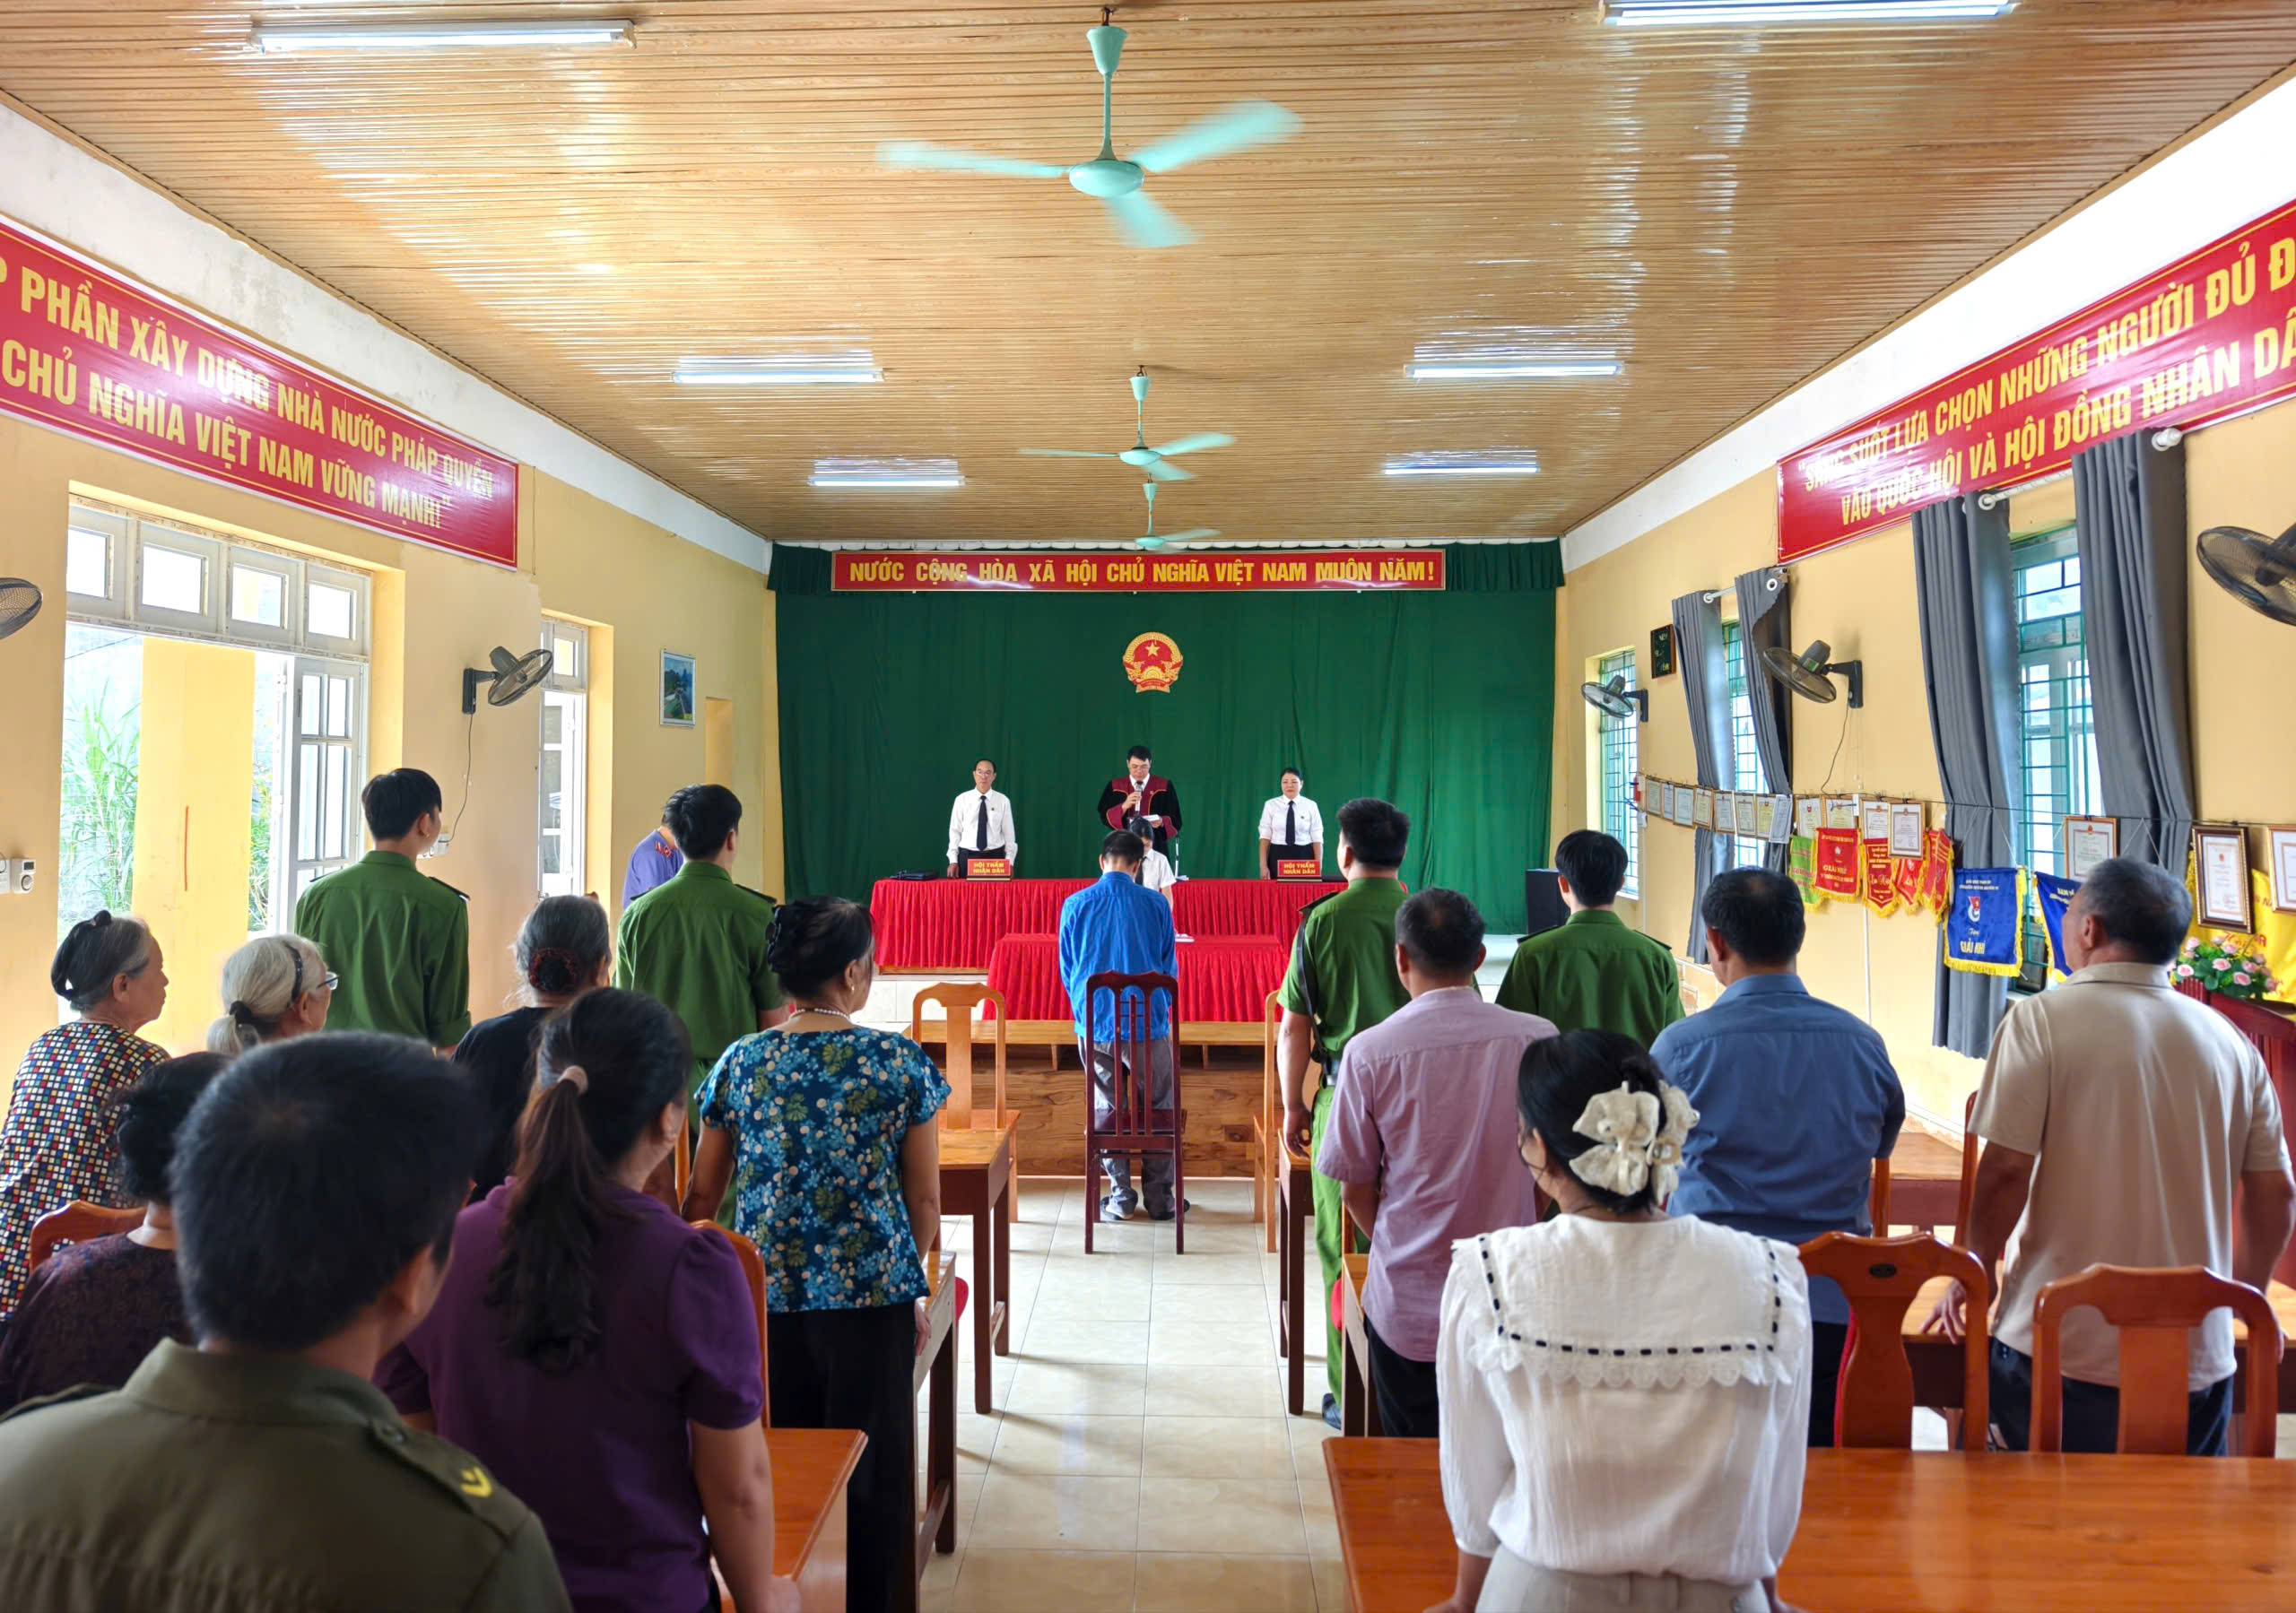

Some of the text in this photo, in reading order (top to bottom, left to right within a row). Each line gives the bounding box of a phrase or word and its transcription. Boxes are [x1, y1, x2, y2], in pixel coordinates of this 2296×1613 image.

[2, 339, 77, 405] CHỦ
[89, 371, 187, 446] NGHĨA
[196, 412, 251, 470] VIỆT
[259, 436, 313, 489] NAM
[321, 458, 376, 508] VỮNG
[22, 265, 119, 351] PHẦN
[129, 316, 189, 377] XÂY
[197, 347, 269, 412] DỰNG
[278, 382, 325, 435] NHÀ
[332, 406, 387, 457] NƯỚC
[392, 430, 439, 474] PHÁP
[443, 455, 492, 499] QUYỀN
[1894, 410, 1928, 455] LỰA
[1935, 378, 1993, 436] CHỌN
[2000, 335, 2088, 409] NHỮNG
[2097, 282, 2194, 366] NGƯỜI
[2205, 240, 2256, 319] ĐỦ
[1929, 447, 1963, 495] HỘI
[1969, 432, 1997, 481] VÀ
[2005, 415, 2046, 470] HỘI
[2053, 384, 2131, 451] ĐỒNG
[2141, 340, 2239, 420] NHÂN
[849, 557, 905, 582] NƯỚC
[916, 558, 968, 585] CỘNG
[978, 558, 1018, 582] HÒA
[1029, 559, 1056, 583] XÃ
[1065, 559, 1098, 586] HỘI
[1106, 556, 1144, 583] CHỦ
[1152, 559, 1210, 583] NGHĨA
[1214, 559, 1255, 586] VIỆT
[1263, 562, 1307, 582] NAM
[1315, 558, 1372, 582] MUÔN
